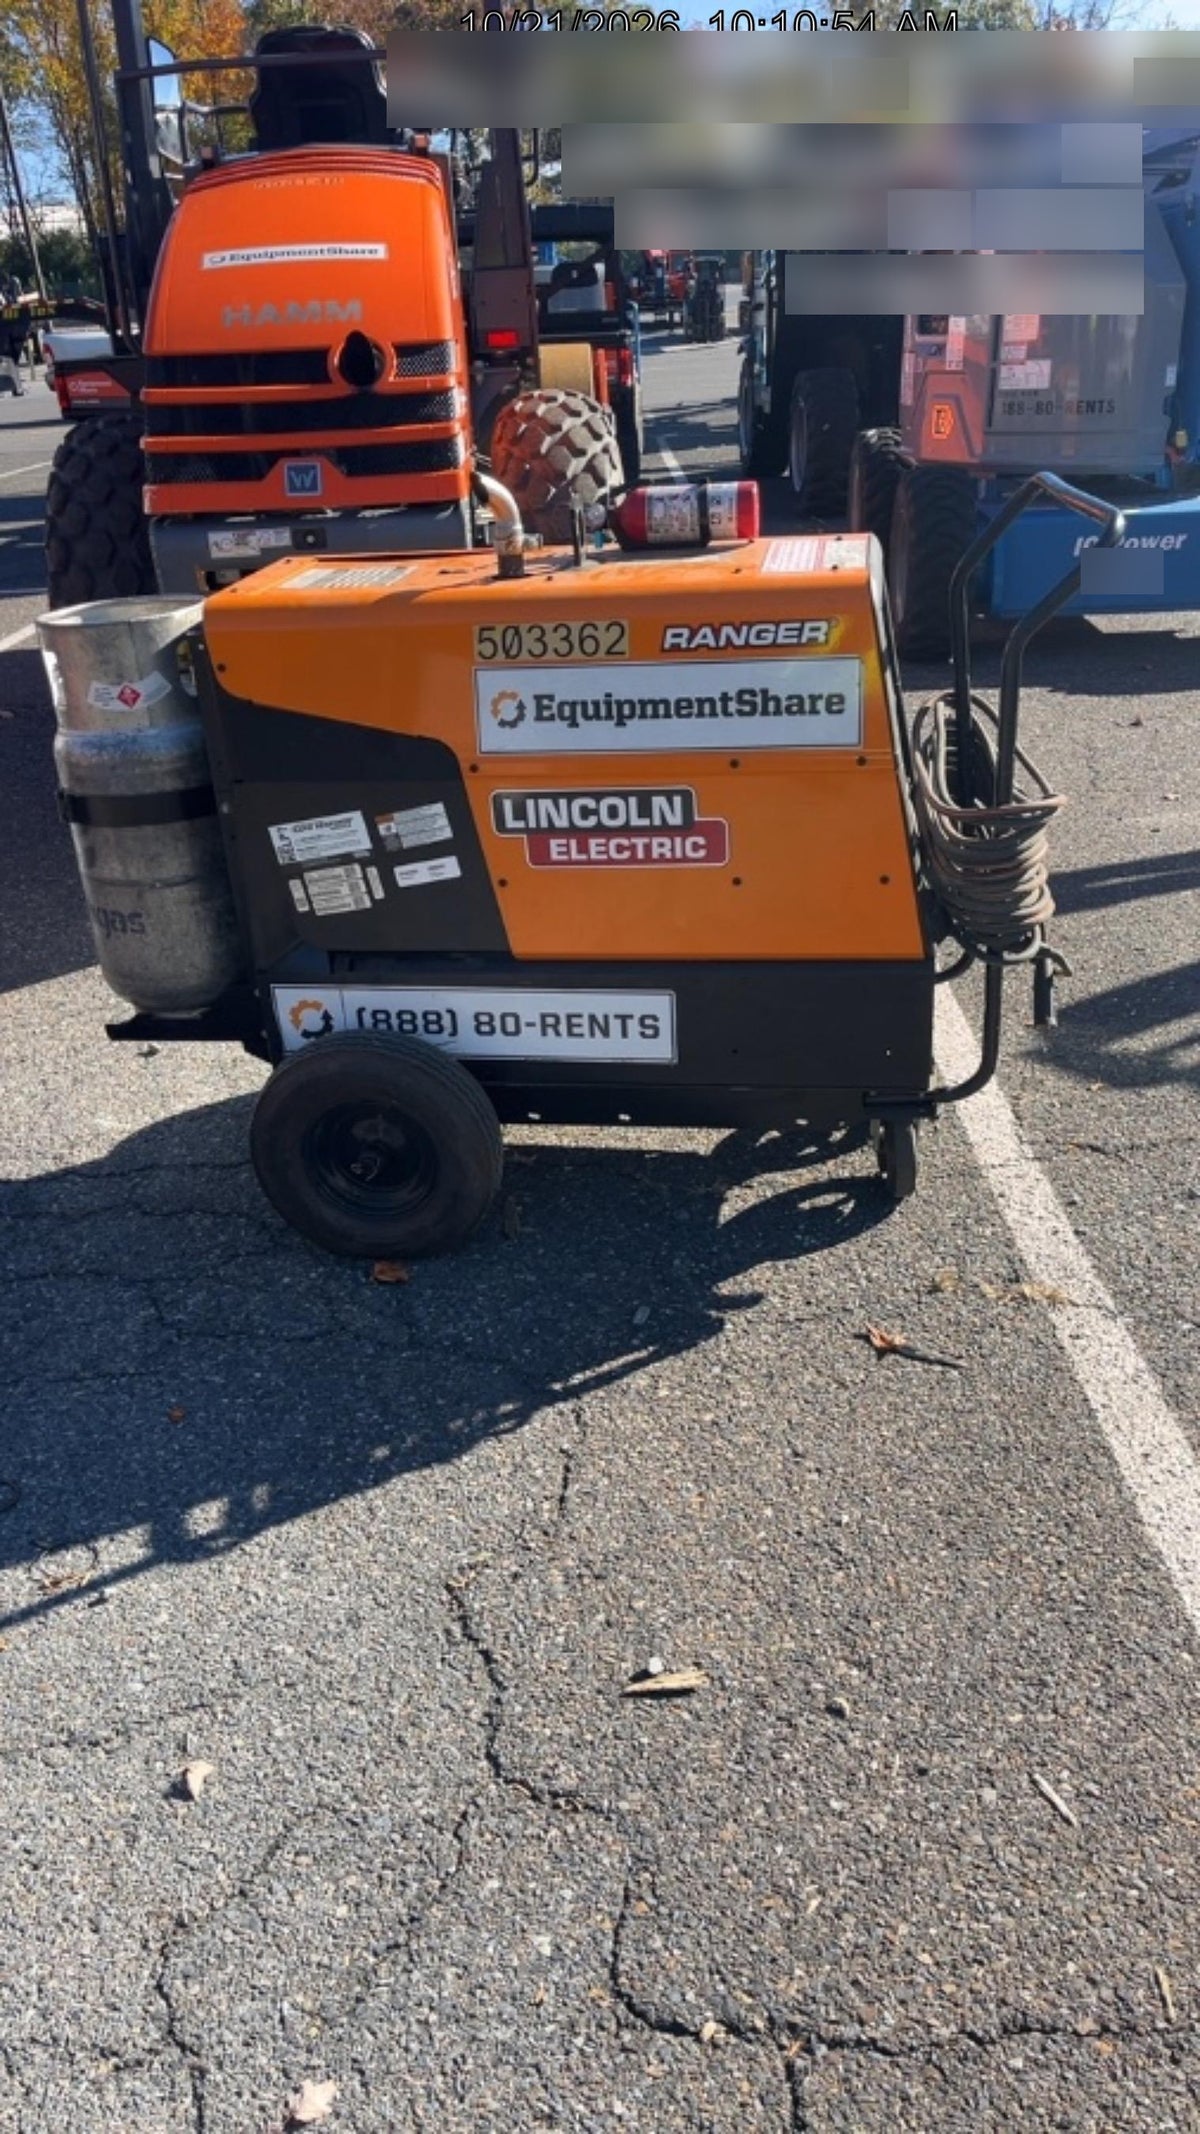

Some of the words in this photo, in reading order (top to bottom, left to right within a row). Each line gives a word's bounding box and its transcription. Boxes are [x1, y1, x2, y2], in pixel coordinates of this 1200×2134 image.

[222, 299, 363, 328] HAMM
[478, 621, 627, 660] 503362
[662, 620, 830, 650] RANGER
[532, 688, 846, 728] EquipmentShare
[501, 795, 684, 829] LINCOLN
[548, 835, 708, 861] ELECTRIC
[356, 1007, 459, 1037] (888)
[473, 1012, 661, 1040] 80-RENTS
